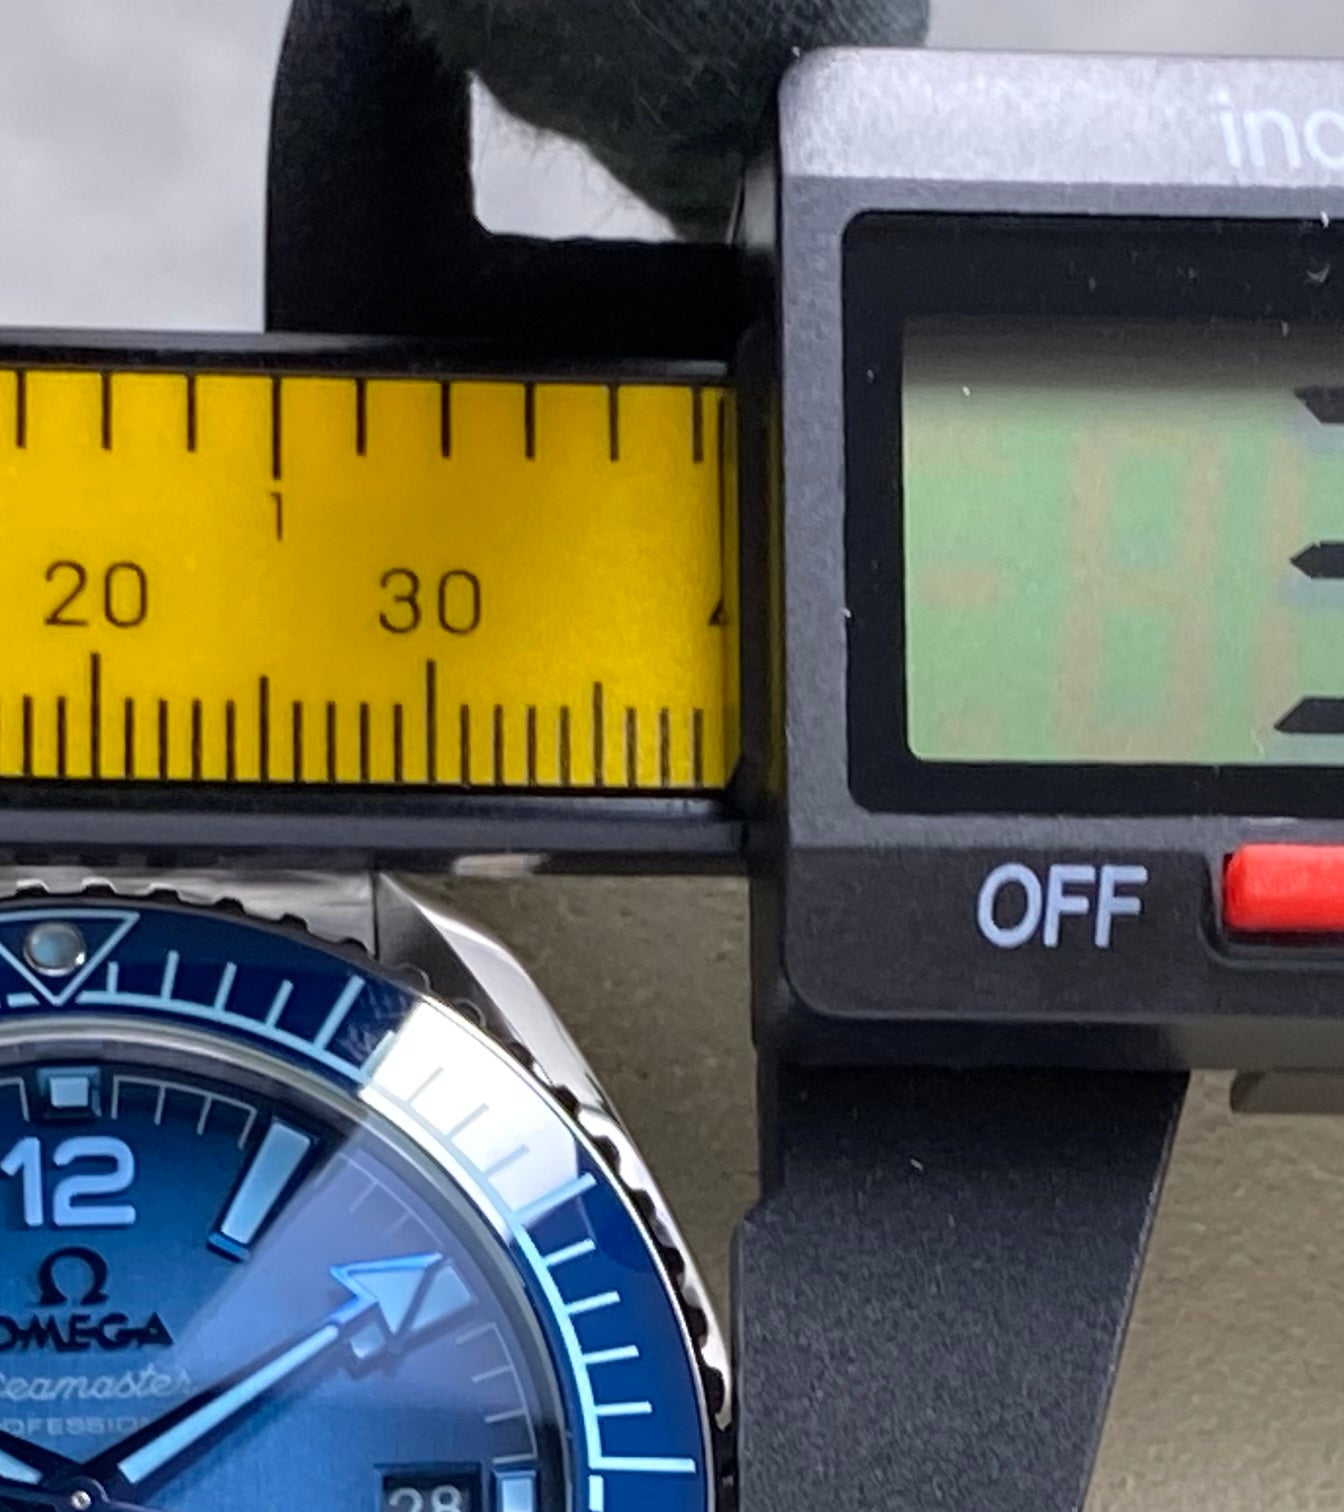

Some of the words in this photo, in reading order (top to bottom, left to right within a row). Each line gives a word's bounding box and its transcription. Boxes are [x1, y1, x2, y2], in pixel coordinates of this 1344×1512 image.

[44, 560, 149, 629] 20
[377, 566, 483, 637] 30
[977, 862, 1149, 947] OFF
[0, 1134, 136, 1227] 12
